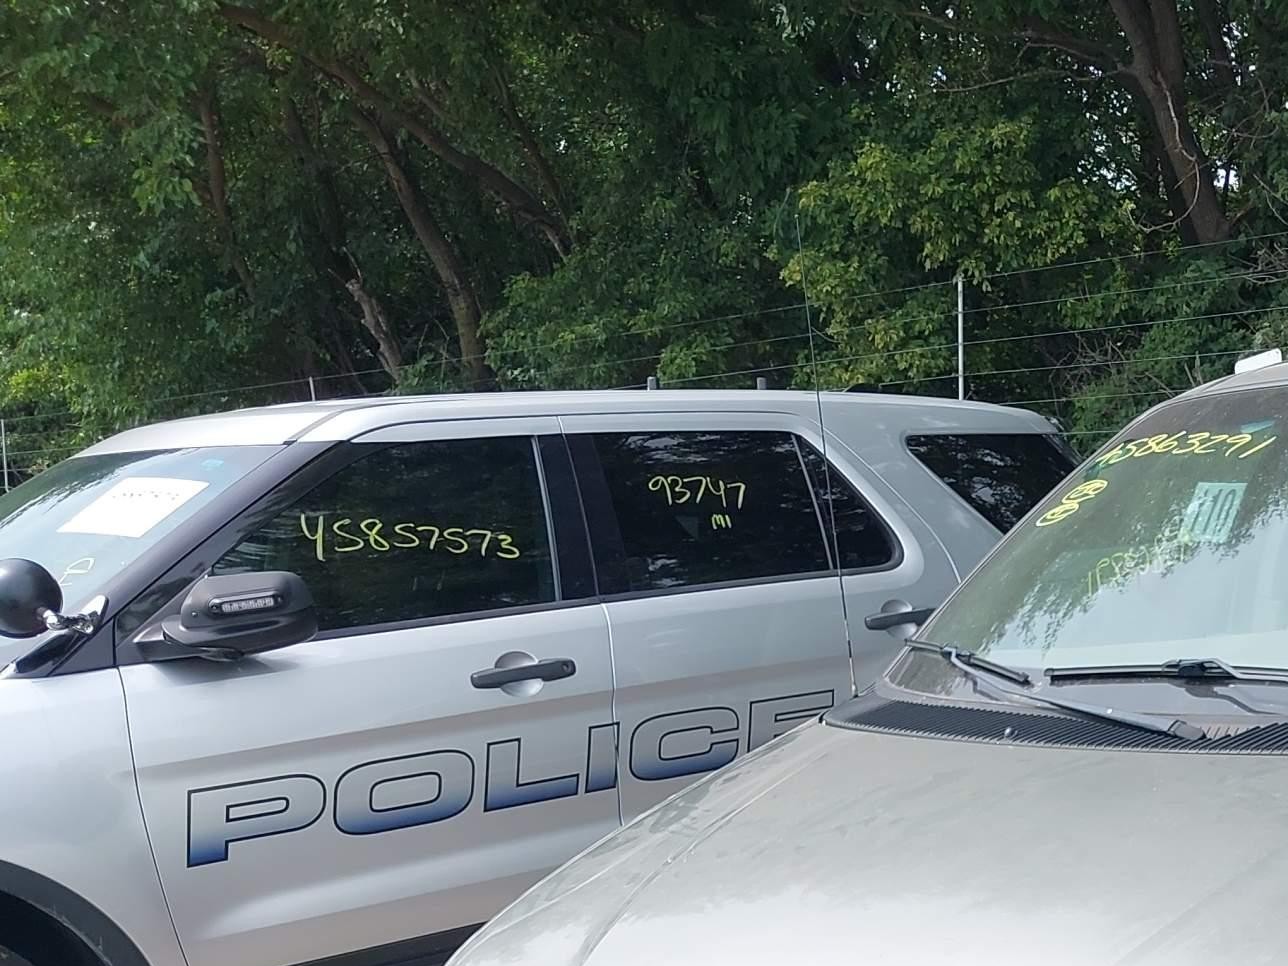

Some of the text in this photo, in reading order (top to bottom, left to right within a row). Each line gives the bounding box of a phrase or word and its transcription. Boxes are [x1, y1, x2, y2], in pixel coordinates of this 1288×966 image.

[1095, 430, 1278, 466] 45863291
[648, 475, 746, 510] 93747
[300, 512, 520, 562] 45857573
